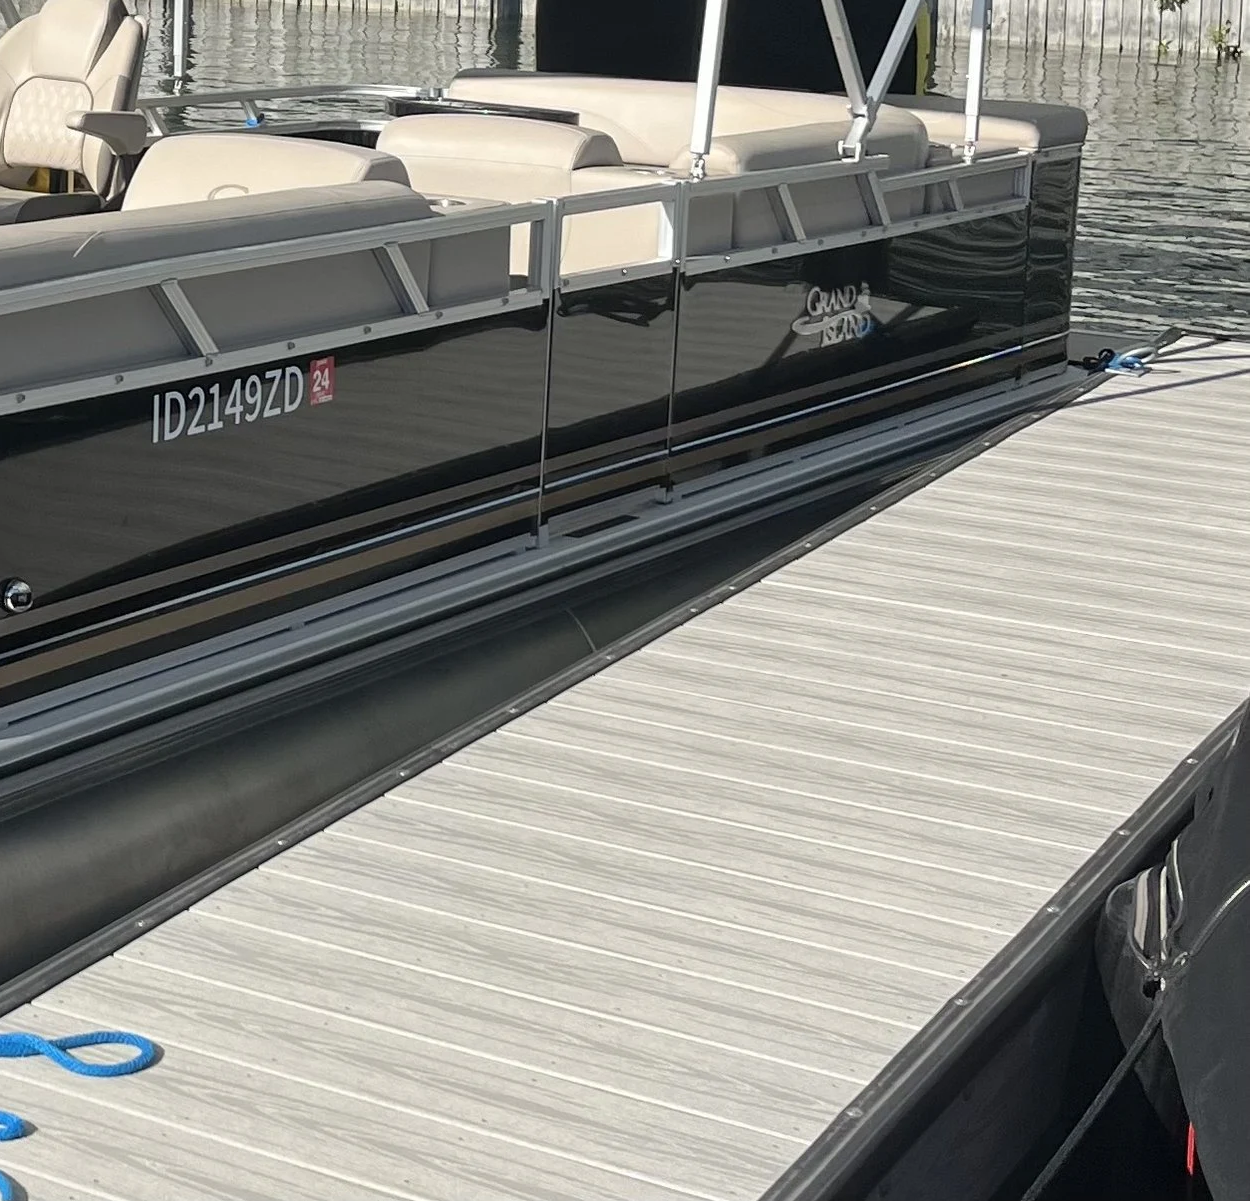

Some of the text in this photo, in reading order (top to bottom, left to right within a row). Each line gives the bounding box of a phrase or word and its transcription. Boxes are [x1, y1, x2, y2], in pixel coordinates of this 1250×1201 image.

[807, 285, 857, 316] GRAND
[820, 313, 871, 348] ISLAND
[312, 367, 330, 393] 24
[152, 365, 304, 443] ID2149ZD
